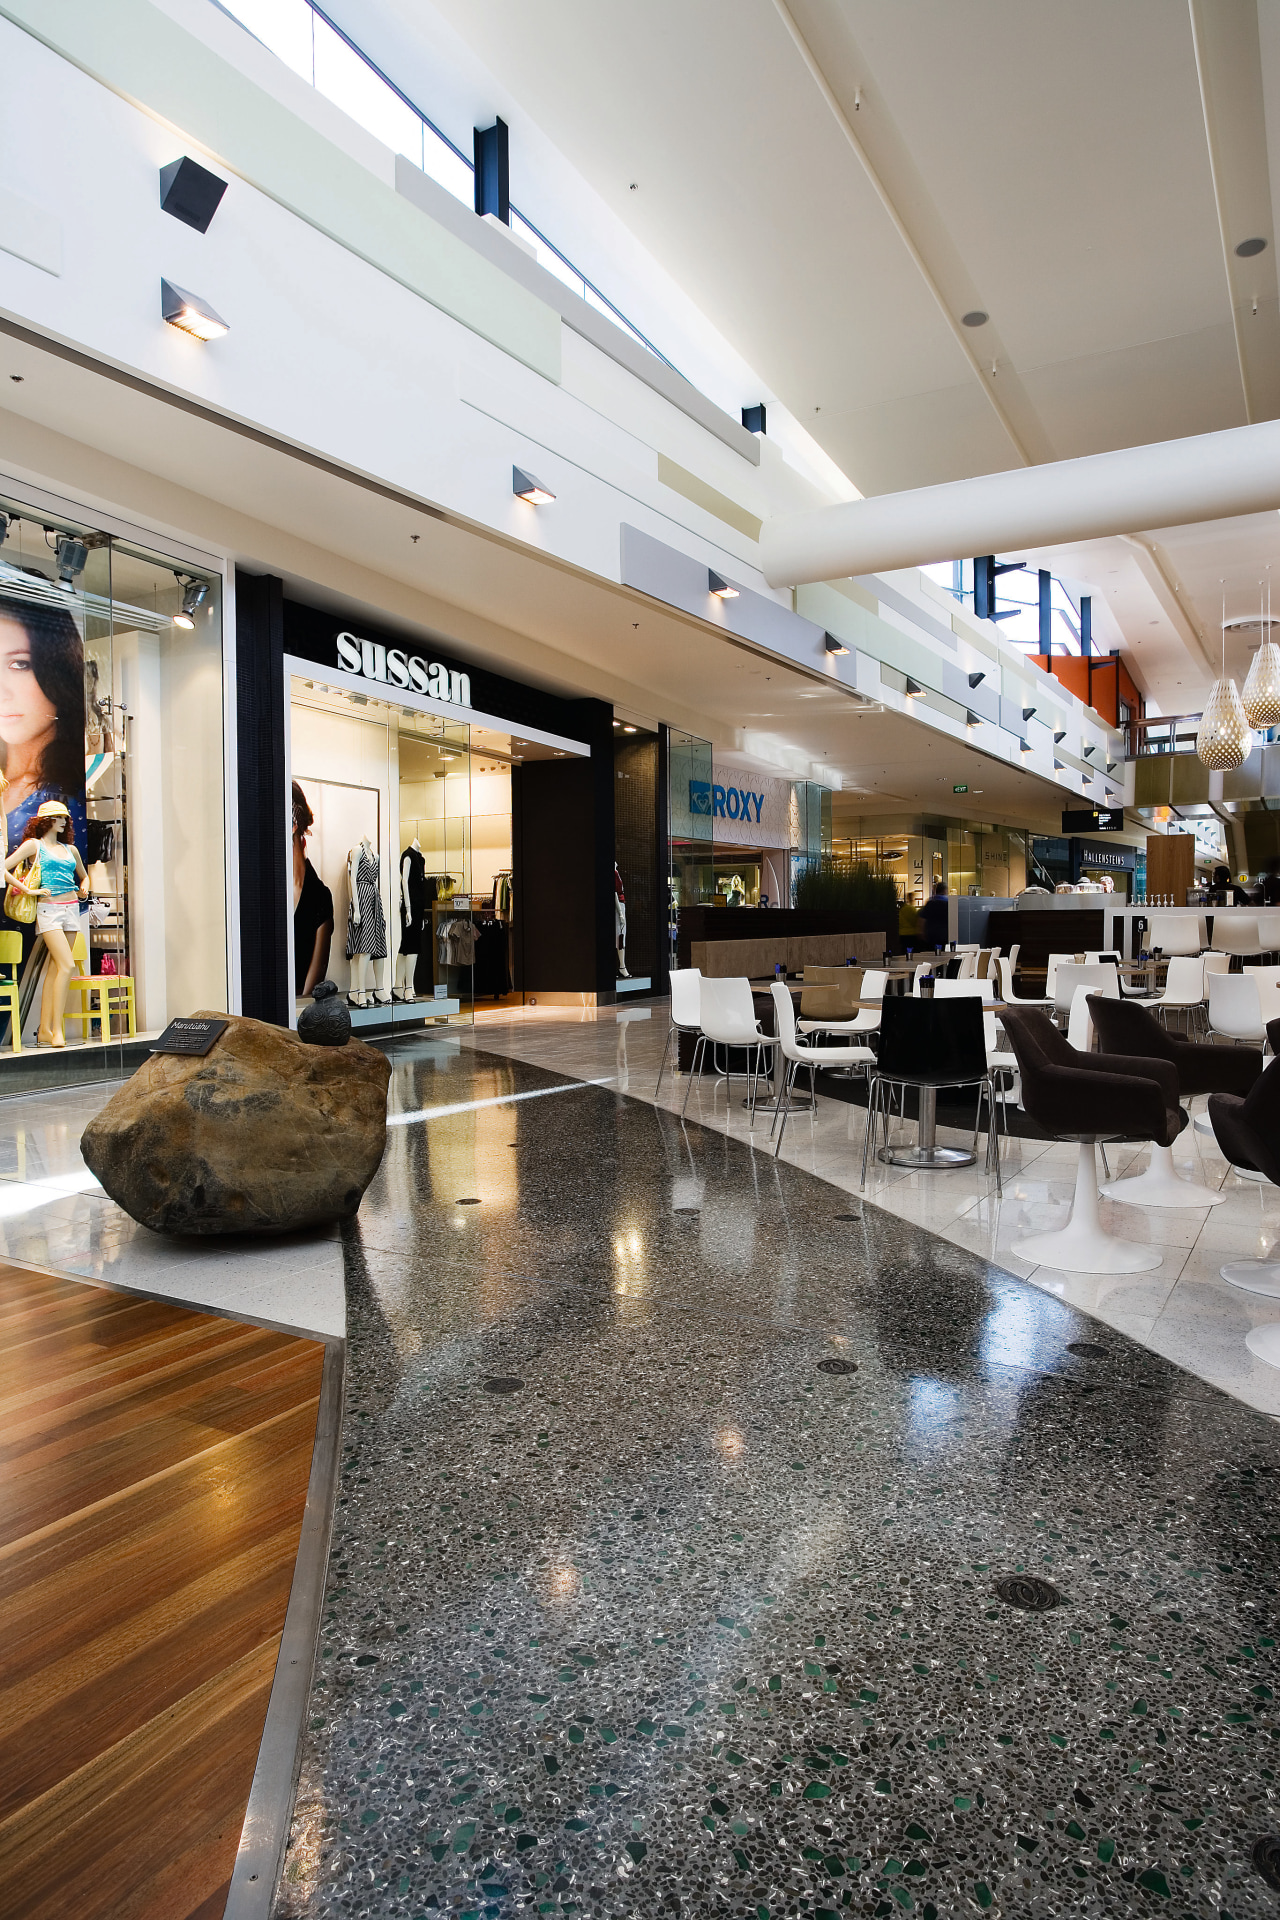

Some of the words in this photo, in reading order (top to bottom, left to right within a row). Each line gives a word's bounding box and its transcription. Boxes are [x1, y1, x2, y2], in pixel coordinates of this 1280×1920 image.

[336, 631, 472, 709] sussan
[713, 784, 765, 823] ROXY
[985, 852, 1007, 862] SHINE
[1083, 849, 1125, 866] HALLENSTEINS
[1138, 920, 1144, 930] 6
